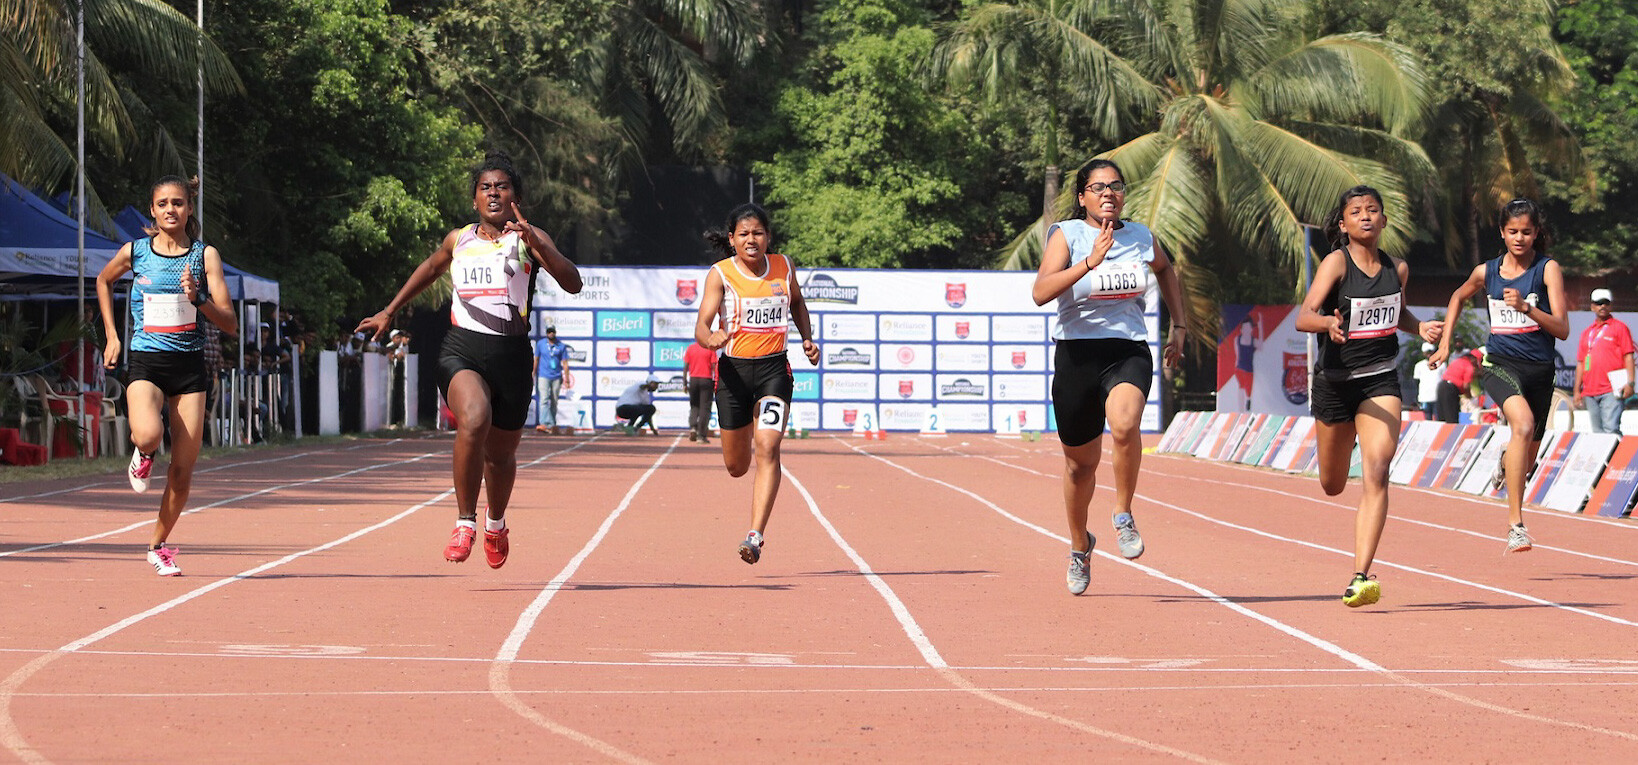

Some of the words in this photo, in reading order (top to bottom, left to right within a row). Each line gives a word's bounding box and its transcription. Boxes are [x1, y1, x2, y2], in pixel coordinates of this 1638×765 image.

[65, 255, 88, 263] YOUH
[463, 267, 492, 285] 1476
[580, 276, 610, 287] OUTH
[1099, 272, 1137, 292] 11363
[603, 317, 644, 332] Bisleri
[747, 307, 782, 325] 20544
[1358, 306, 1395, 326] 12970
[661, 346, 686, 361] Bisl
[578, 411, 587, 426] 7
[763, 402, 781, 425] 5
[864, 413, 872, 431] 3
[930, 414, 938, 431] 2
[1004, 415, 1011, 432] 1
